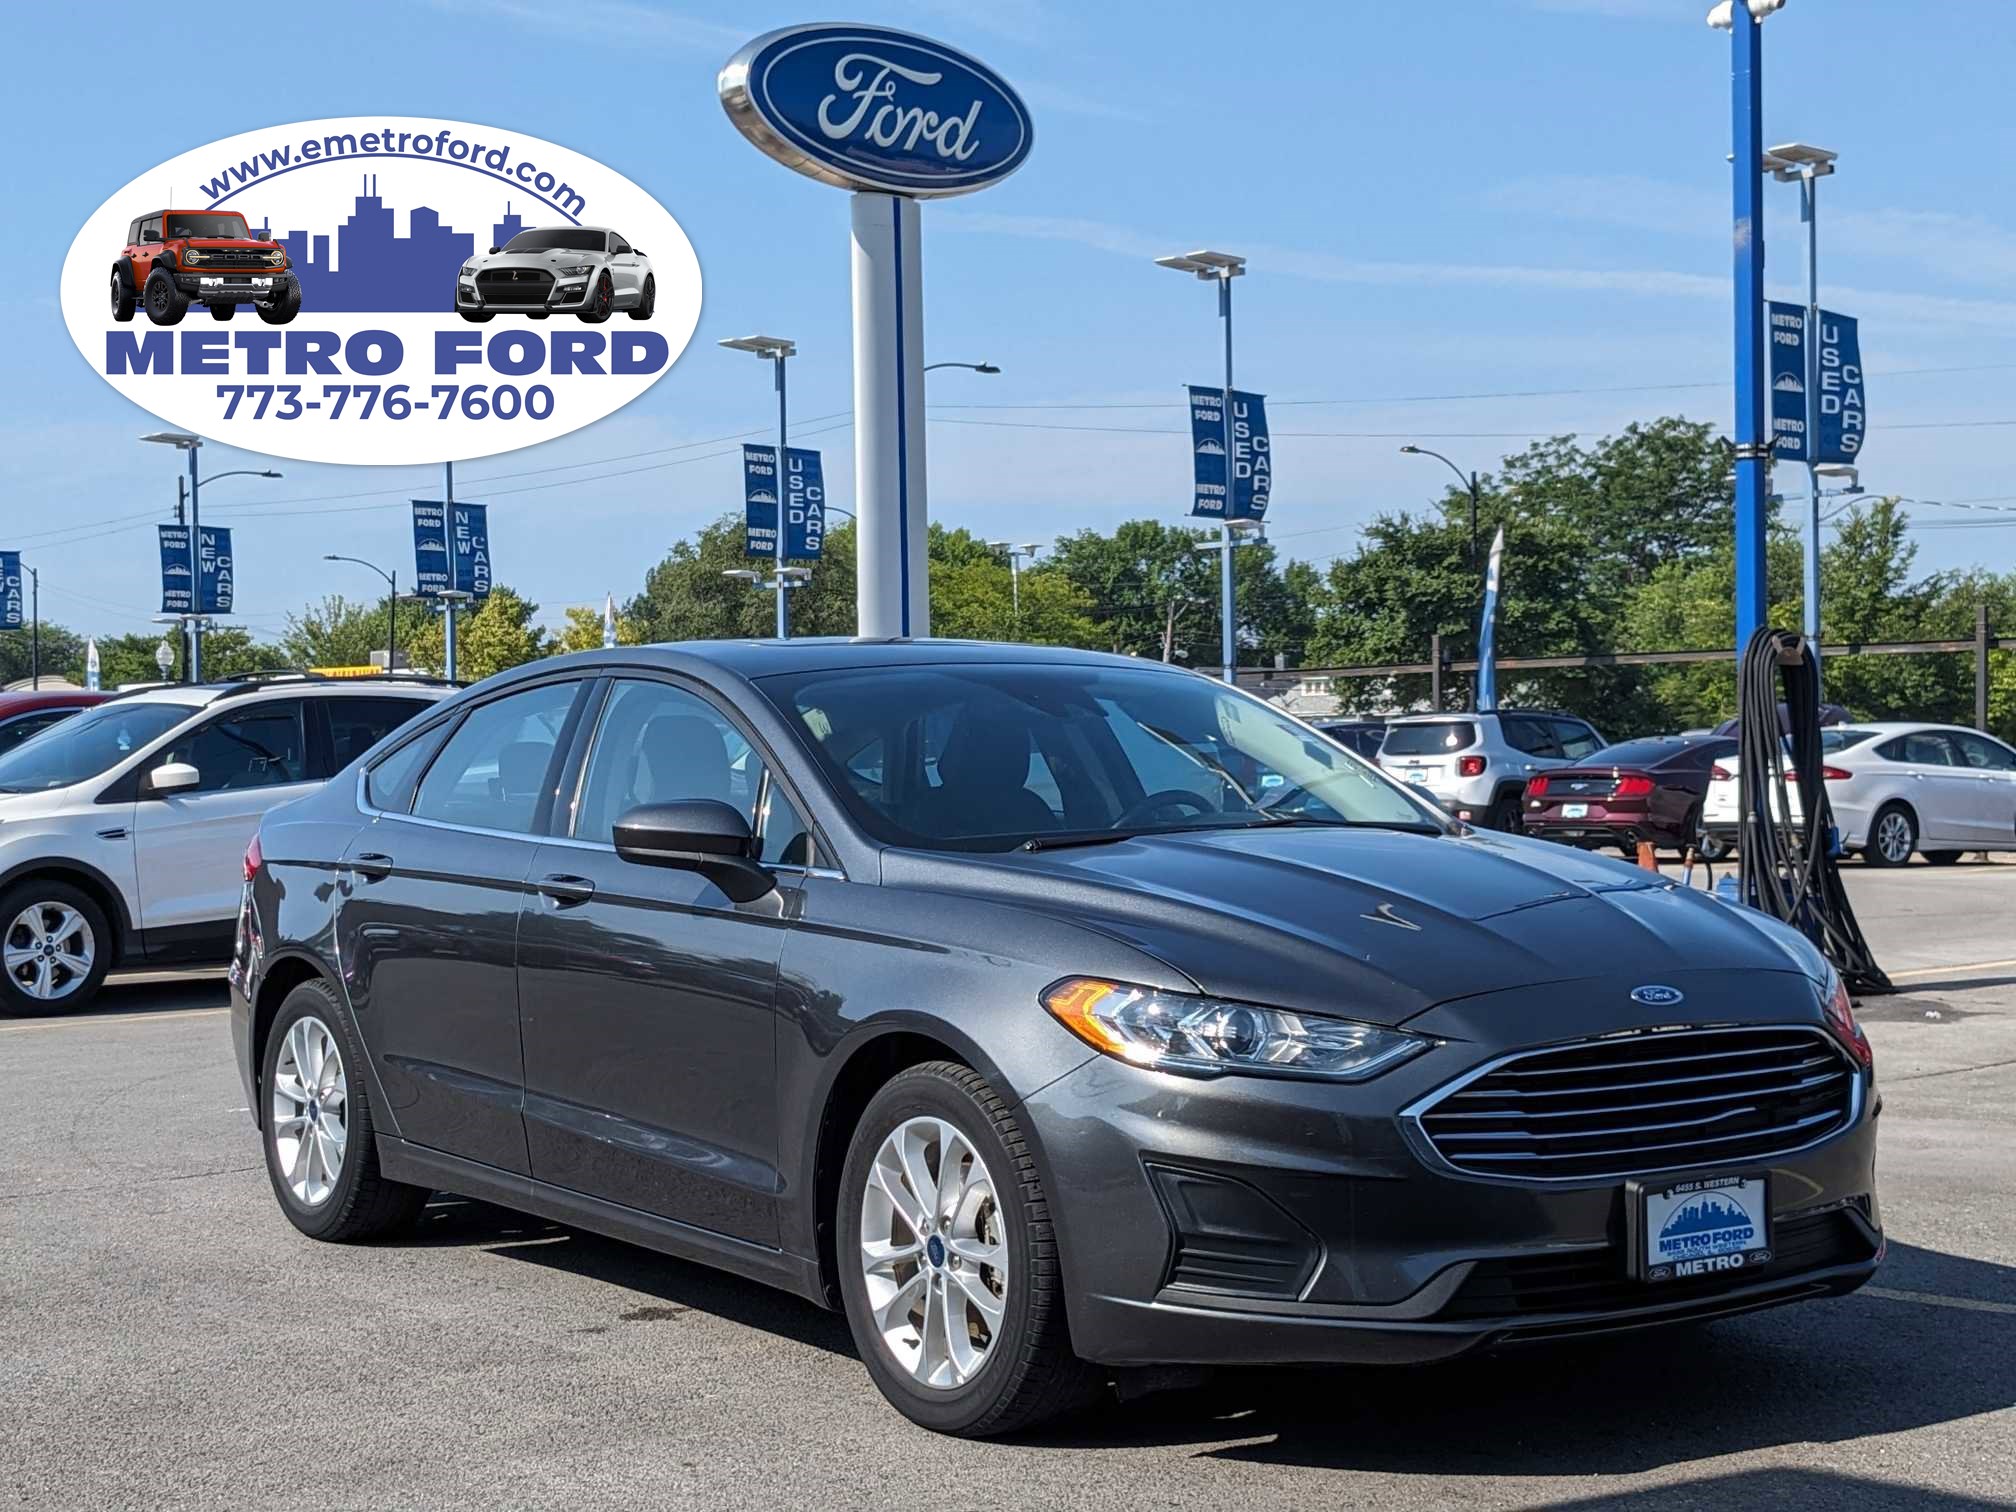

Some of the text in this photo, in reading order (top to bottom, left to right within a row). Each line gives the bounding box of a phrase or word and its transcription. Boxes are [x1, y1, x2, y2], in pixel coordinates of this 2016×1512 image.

[818, 53, 983, 161] Ford
[1771, 313, 1802, 328] METRO
[1774, 331, 1800, 346] FORD
[1822, 325, 1840, 414] USED
[1191, 395, 1223, 407] METRO
[1195, 409, 1221, 422] FORD
[1840, 365, 1863, 453] CARS
[1774, 418, 1805, 433] METRO
[1234, 402, 1251, 478] USED
[745, 451, 775, 464] METRO
[749, 464, 774, 476] FORD
[1251, 436, 1270, 510] CARS
[789, 458, 805, 524] USED
[1196, 483, 1226, 496] METRO
[414, 507, 443, 517] METRO
[1199, 499, 1223, 510] FORD
[417, 518, 442, 528] FORD
[805, 487, 822, 550] CARS
[160, 531, 189, 539] METRO
[455, 511, 470, 554] NEW
[748, 527, 777, 539] METRO
[163, 541, 187, 549] FORD
[750, 540, 774, 551] FORD
[201, 533, 216, 573] NEW
[472, 536, 489, 592] CARS
[216, 556, 232, 607] CARS
[419, 572, 448, 583] METRO
[6, 576, 21, 624] CARS
[164, 590, 192, 599] METRO
[166, 600, 189, 608] FORD
[1659, 1234, 1711, 1253] METRO
[1712, 1227, 1754, 1244] FORD
[1675, 1253, 1744, 1277] METRO
